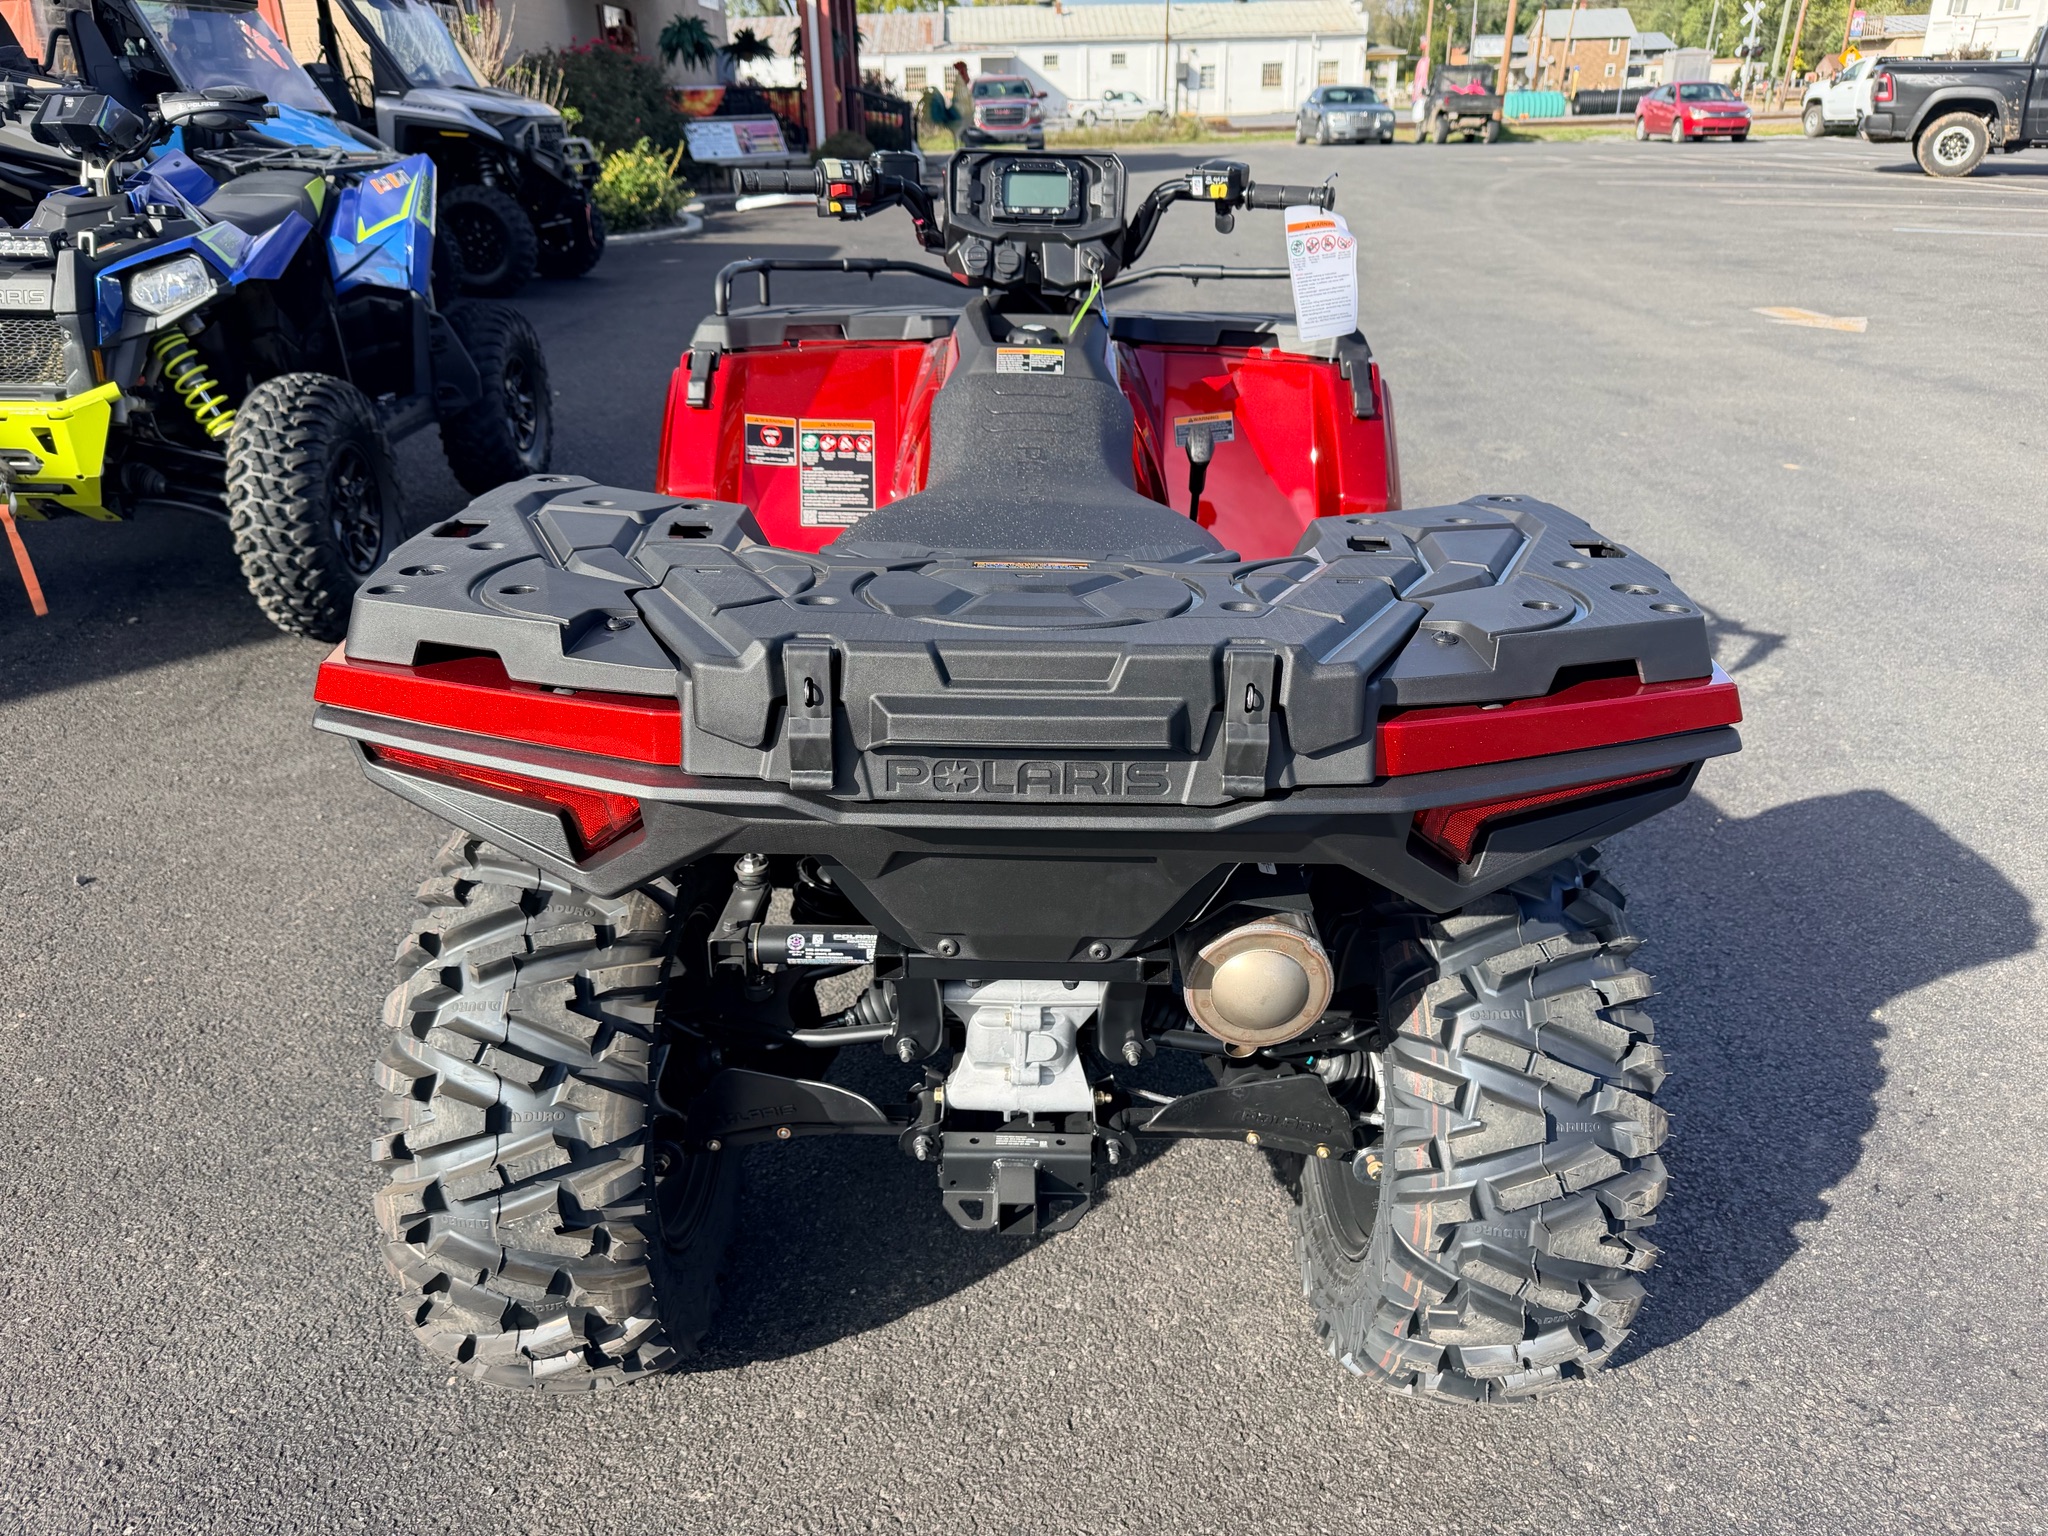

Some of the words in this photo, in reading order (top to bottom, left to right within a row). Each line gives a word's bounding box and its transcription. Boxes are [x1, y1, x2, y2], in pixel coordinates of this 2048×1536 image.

[886, 758, 1172, 796] POLARIS
[554, 904, 596, 918] DURO
[522, 1111, 566, 1122] DURO
[716, 1103, 797, 1125] OLARIS
[1566, 1122, 1601, 1133] DURO
